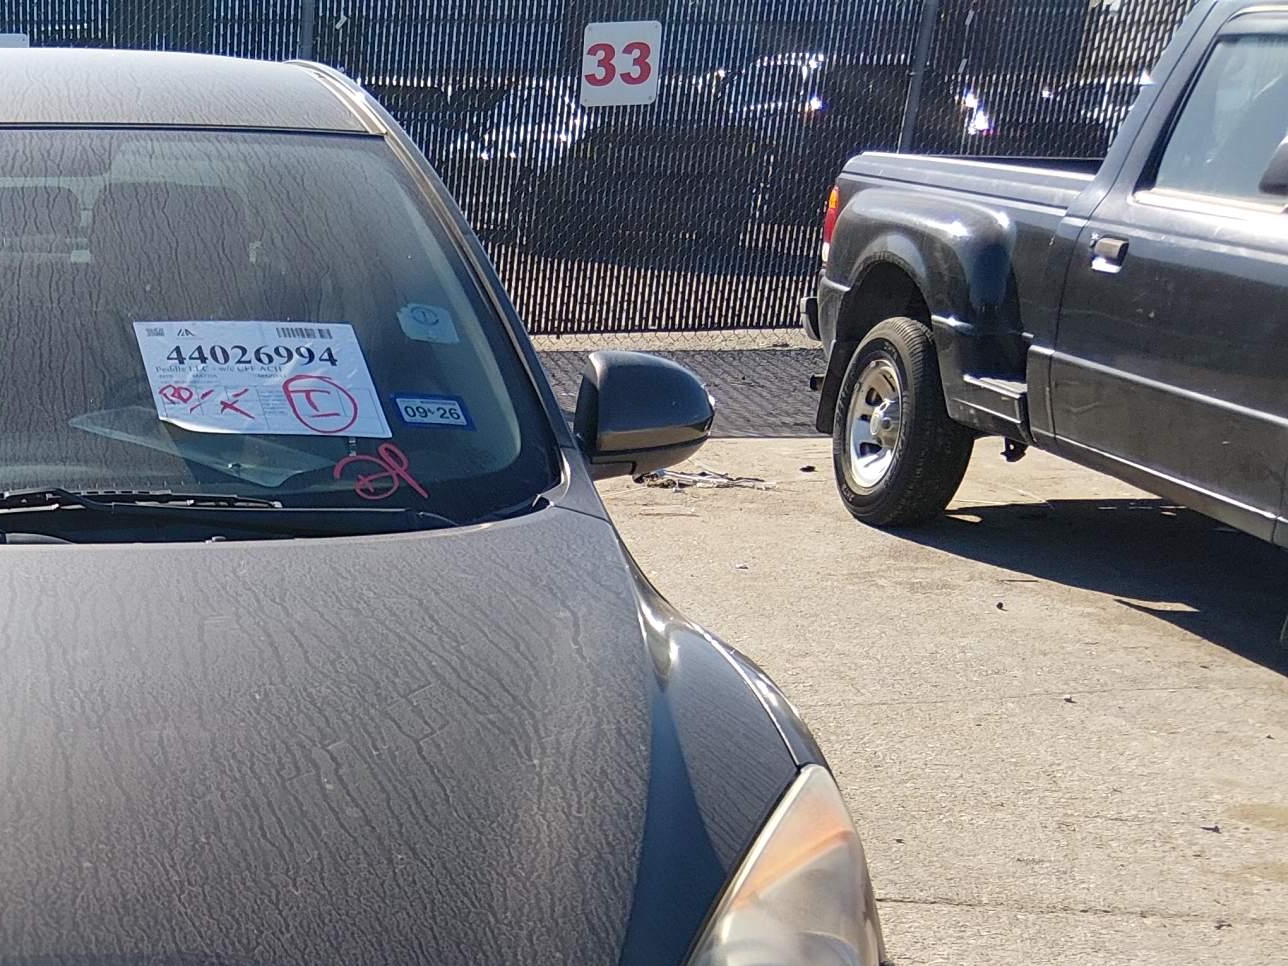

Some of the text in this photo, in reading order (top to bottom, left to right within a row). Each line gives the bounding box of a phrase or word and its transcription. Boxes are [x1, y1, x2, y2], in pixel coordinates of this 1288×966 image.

[584, 42, 651, 86] 33
[166, 344, 338, 367] 44026994
[404, 405, 461, 420] 09 26
